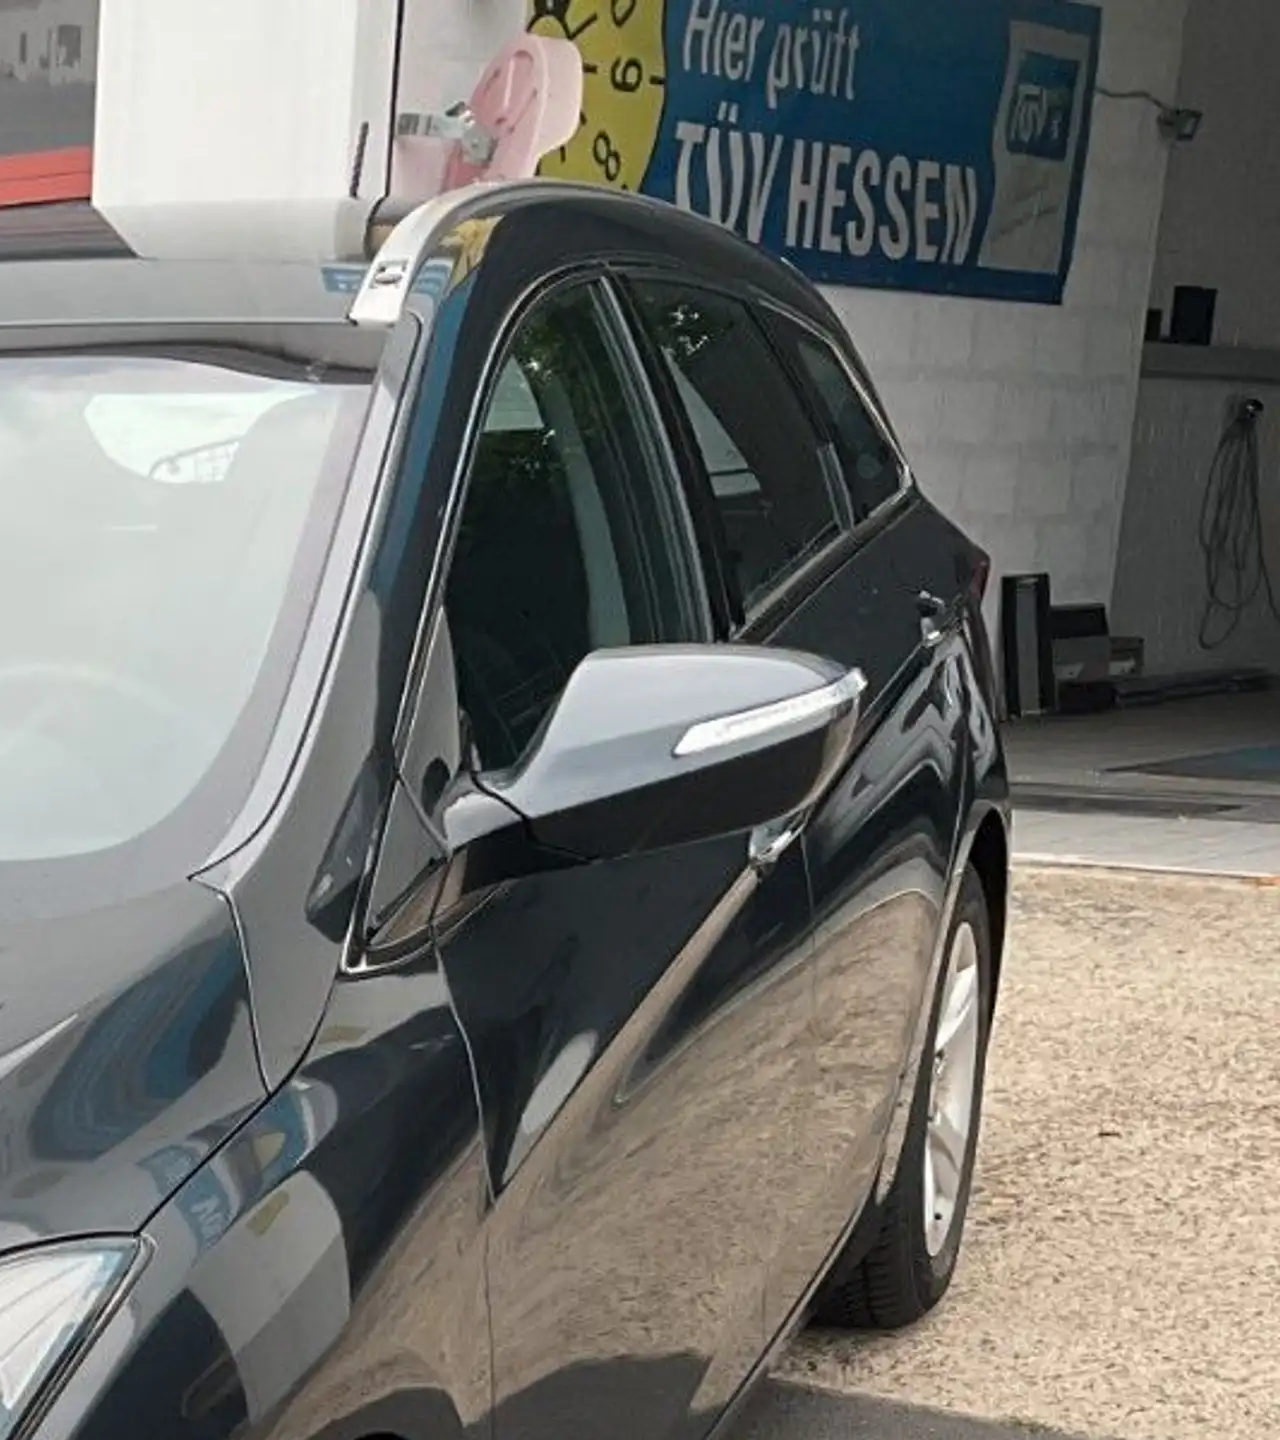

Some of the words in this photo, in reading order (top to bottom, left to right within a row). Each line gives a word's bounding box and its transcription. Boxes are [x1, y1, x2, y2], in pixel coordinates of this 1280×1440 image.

[682, 0, 765, 82] Hier
[767, 8, 860, 109] prüft
[676, 102, 784, 244] TÜV
[787, 139, 977, 266] HESSEN
